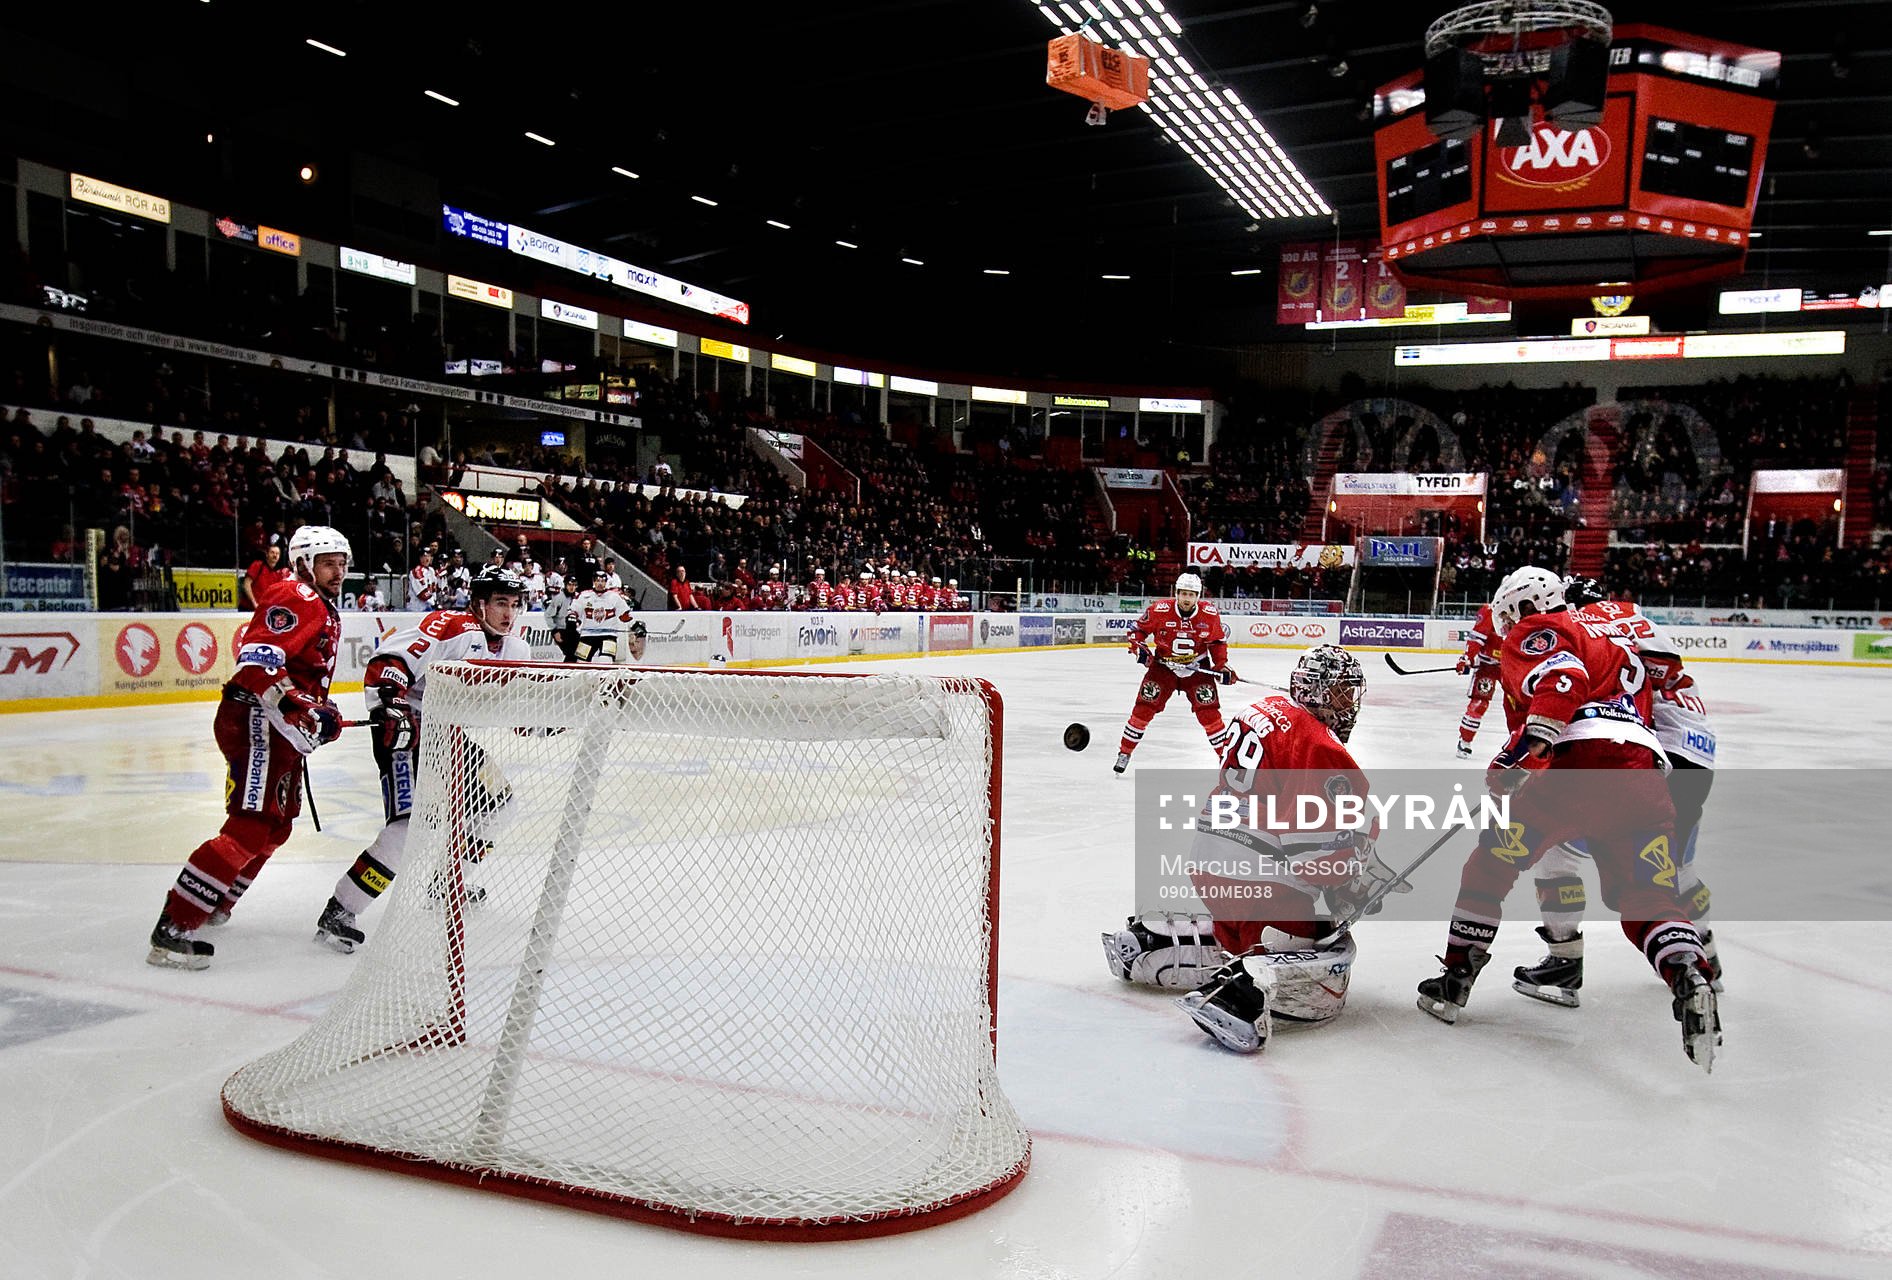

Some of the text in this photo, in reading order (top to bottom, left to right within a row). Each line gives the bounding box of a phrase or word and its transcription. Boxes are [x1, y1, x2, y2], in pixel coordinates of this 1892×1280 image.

[1511, 130, 1599, 171] AXA
[151, 204, 166, 216] AB
[265, 233, 295, 250] office
[1190, 546, 1223, 564] ICA
[735, 625, 781, 640] Riksbyggen
[1342, 624, 1423, 640] AstraZeneca
[247, 708, 265, 810] Handelsbanken
[395, 762, 413, 812] STENA
[180, 873, 219, 902] SCANIA
